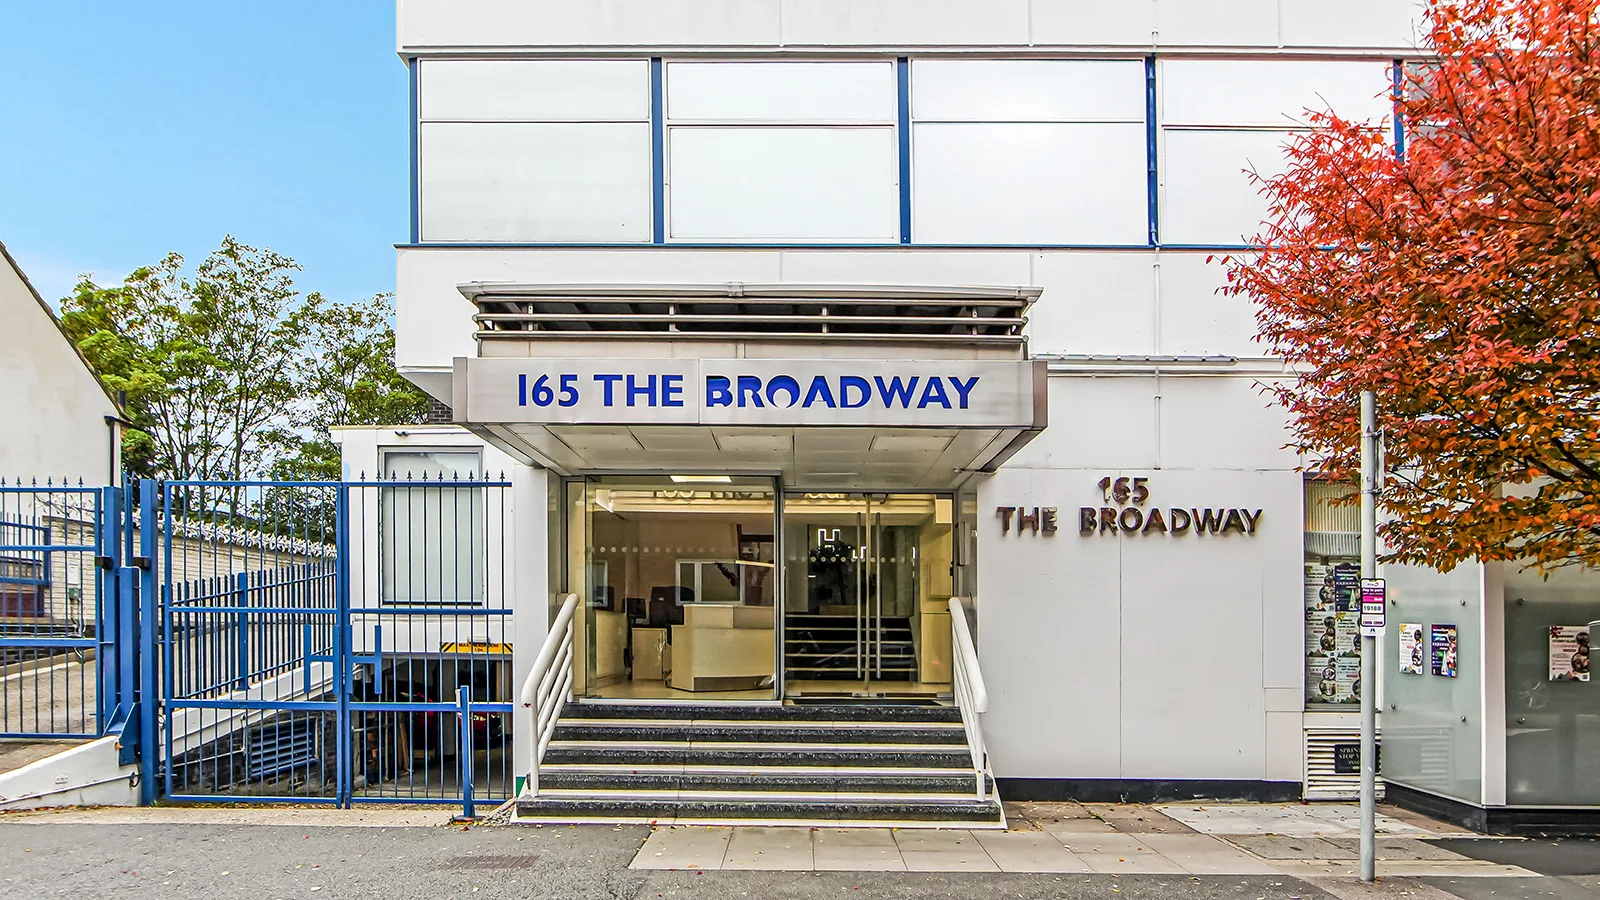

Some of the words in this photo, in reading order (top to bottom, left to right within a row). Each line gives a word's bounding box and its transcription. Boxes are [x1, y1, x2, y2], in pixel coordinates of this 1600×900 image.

[518, 373, 580, 408] 165
[594, 374, 685, 408] THE
[705, 375, 981, 410] BROADWAY
[1098, 476, 1150, 503] 165
[996, 506, 1059, 534] THE
[1079, 507, 1264, 535] BROADWAY
